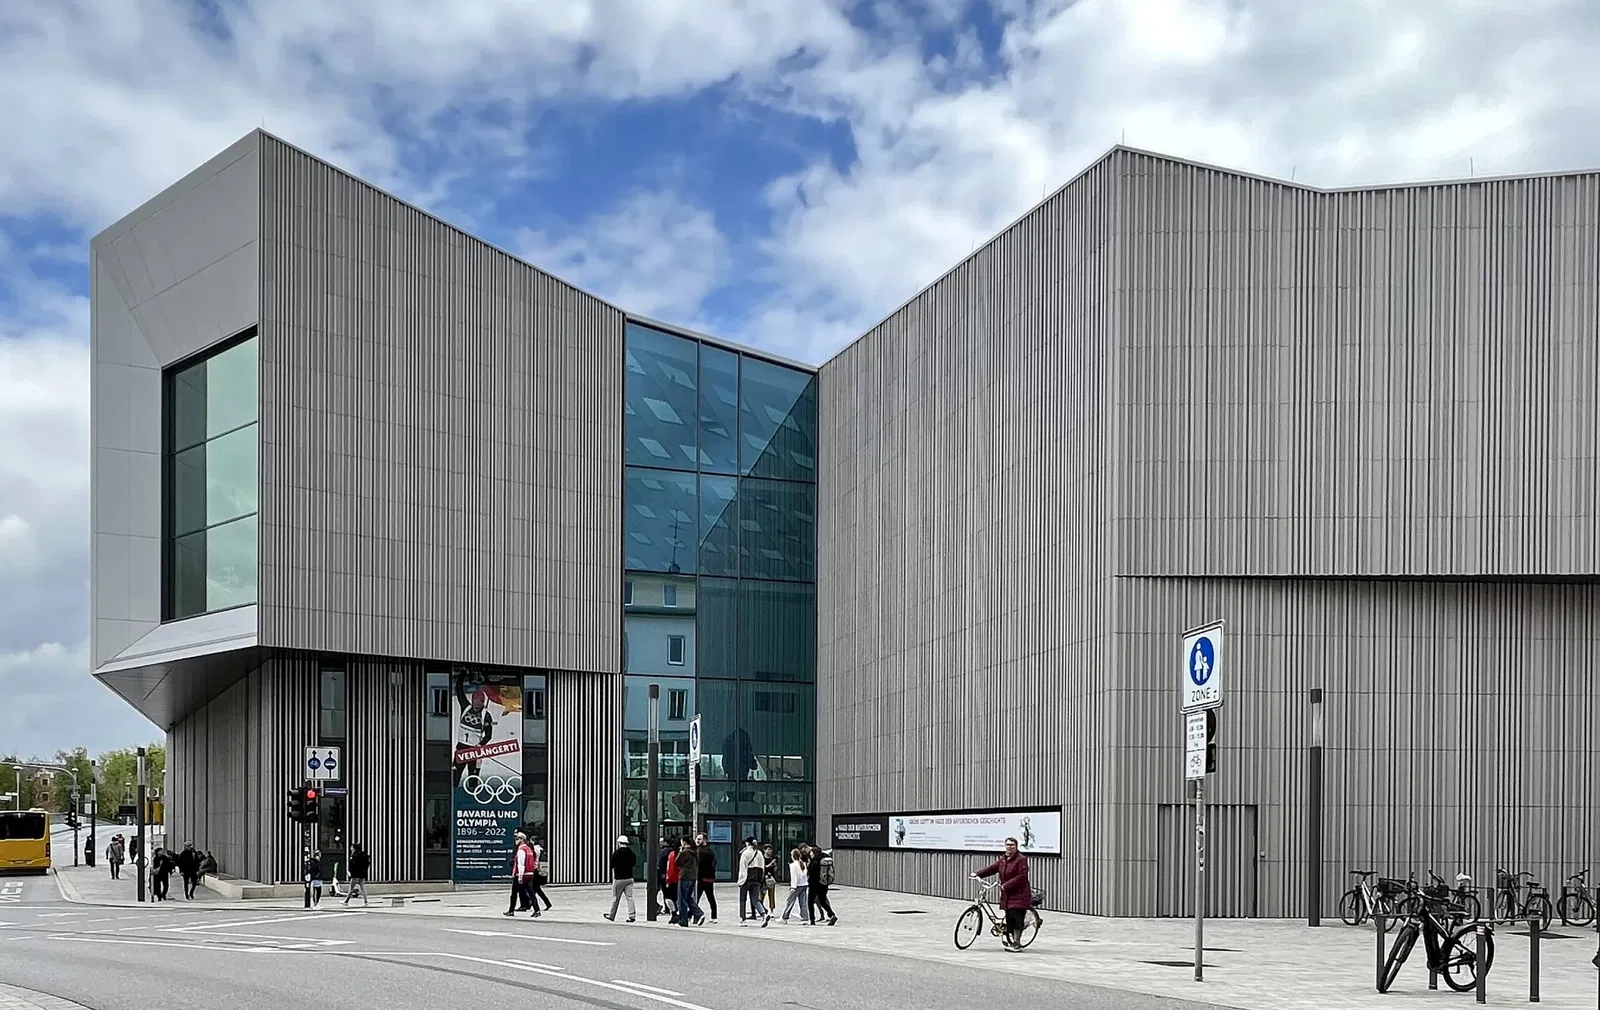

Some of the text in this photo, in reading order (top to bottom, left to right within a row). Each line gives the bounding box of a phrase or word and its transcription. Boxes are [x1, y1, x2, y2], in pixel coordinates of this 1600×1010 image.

[1191, 687, 1211, 702] ZONE
[458, 743, 518, 761] VERLÄNGERT!
[456, 810, 518, 818] BAVARIA UND
[456, 819, 498, 827] OLYMPIA
